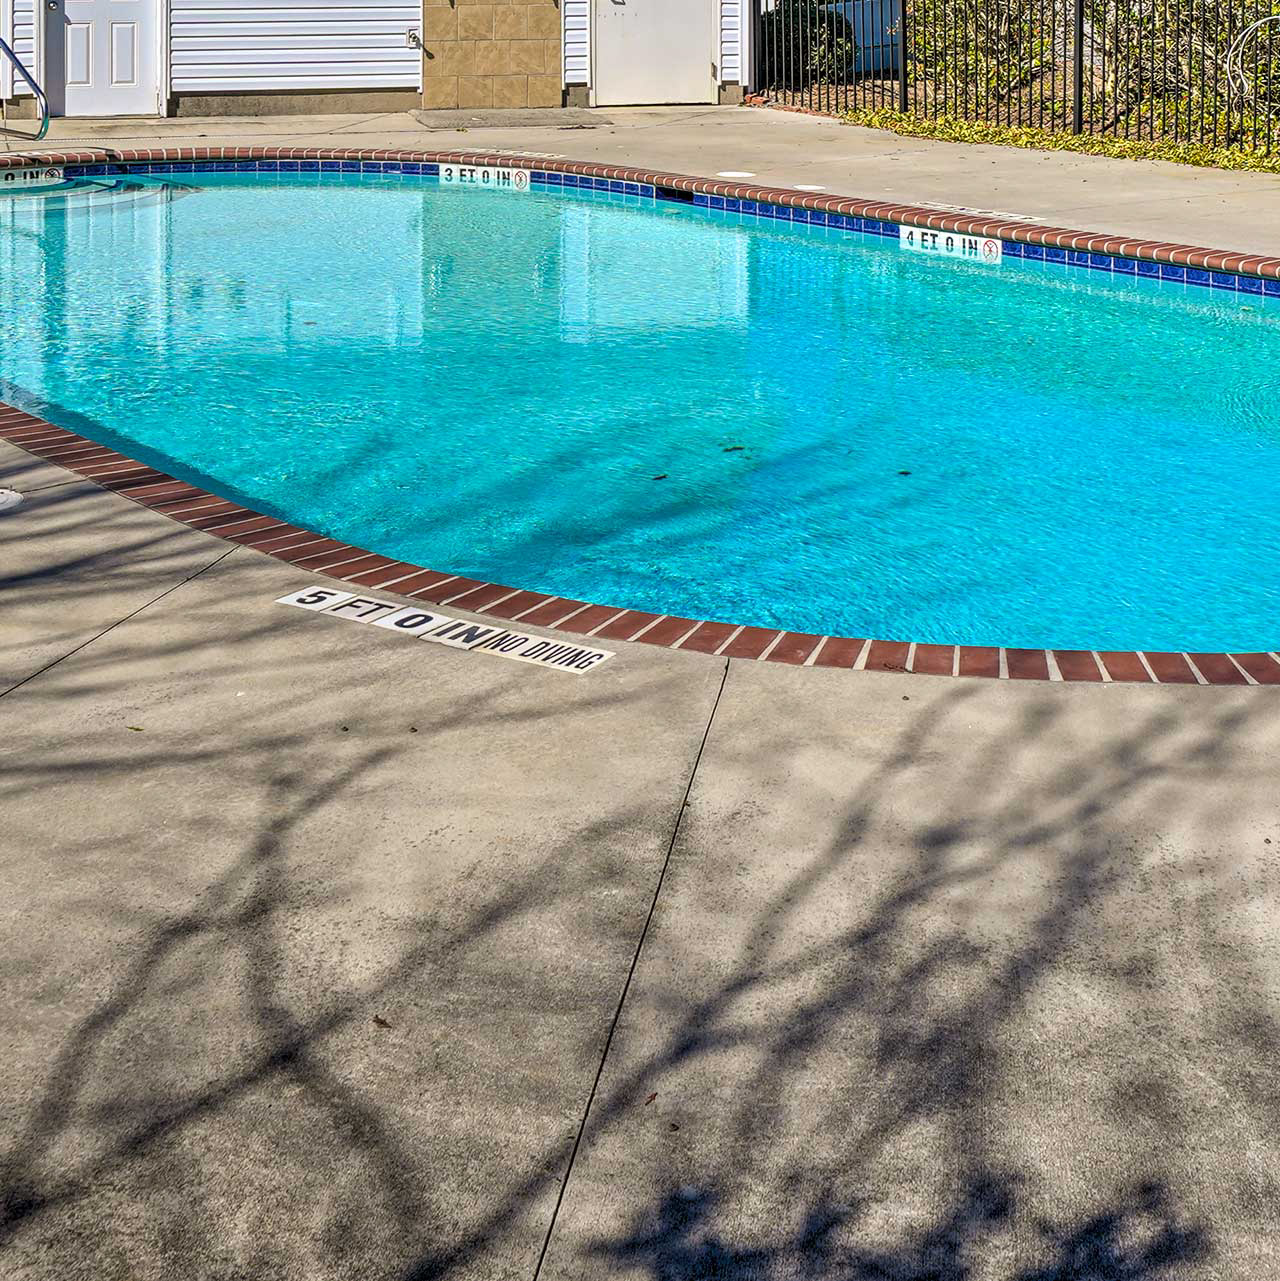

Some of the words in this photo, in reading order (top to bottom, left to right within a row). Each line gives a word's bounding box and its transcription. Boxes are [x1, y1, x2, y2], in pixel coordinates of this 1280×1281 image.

[444, 167, 453, 182] 3
[460, 168, 476, 183] FT
[497, 170, 511, 186] IN
[921, 232, 939, 249] FT
[962, 238, 978, 255] IN
[295, 590, 337, 605] 5
[328, 599, 396, 618] FT
[433, 622, 493, 645] IN
[483, 632, 521, 653] NO
[520, 639, 604, 670] DIVING
